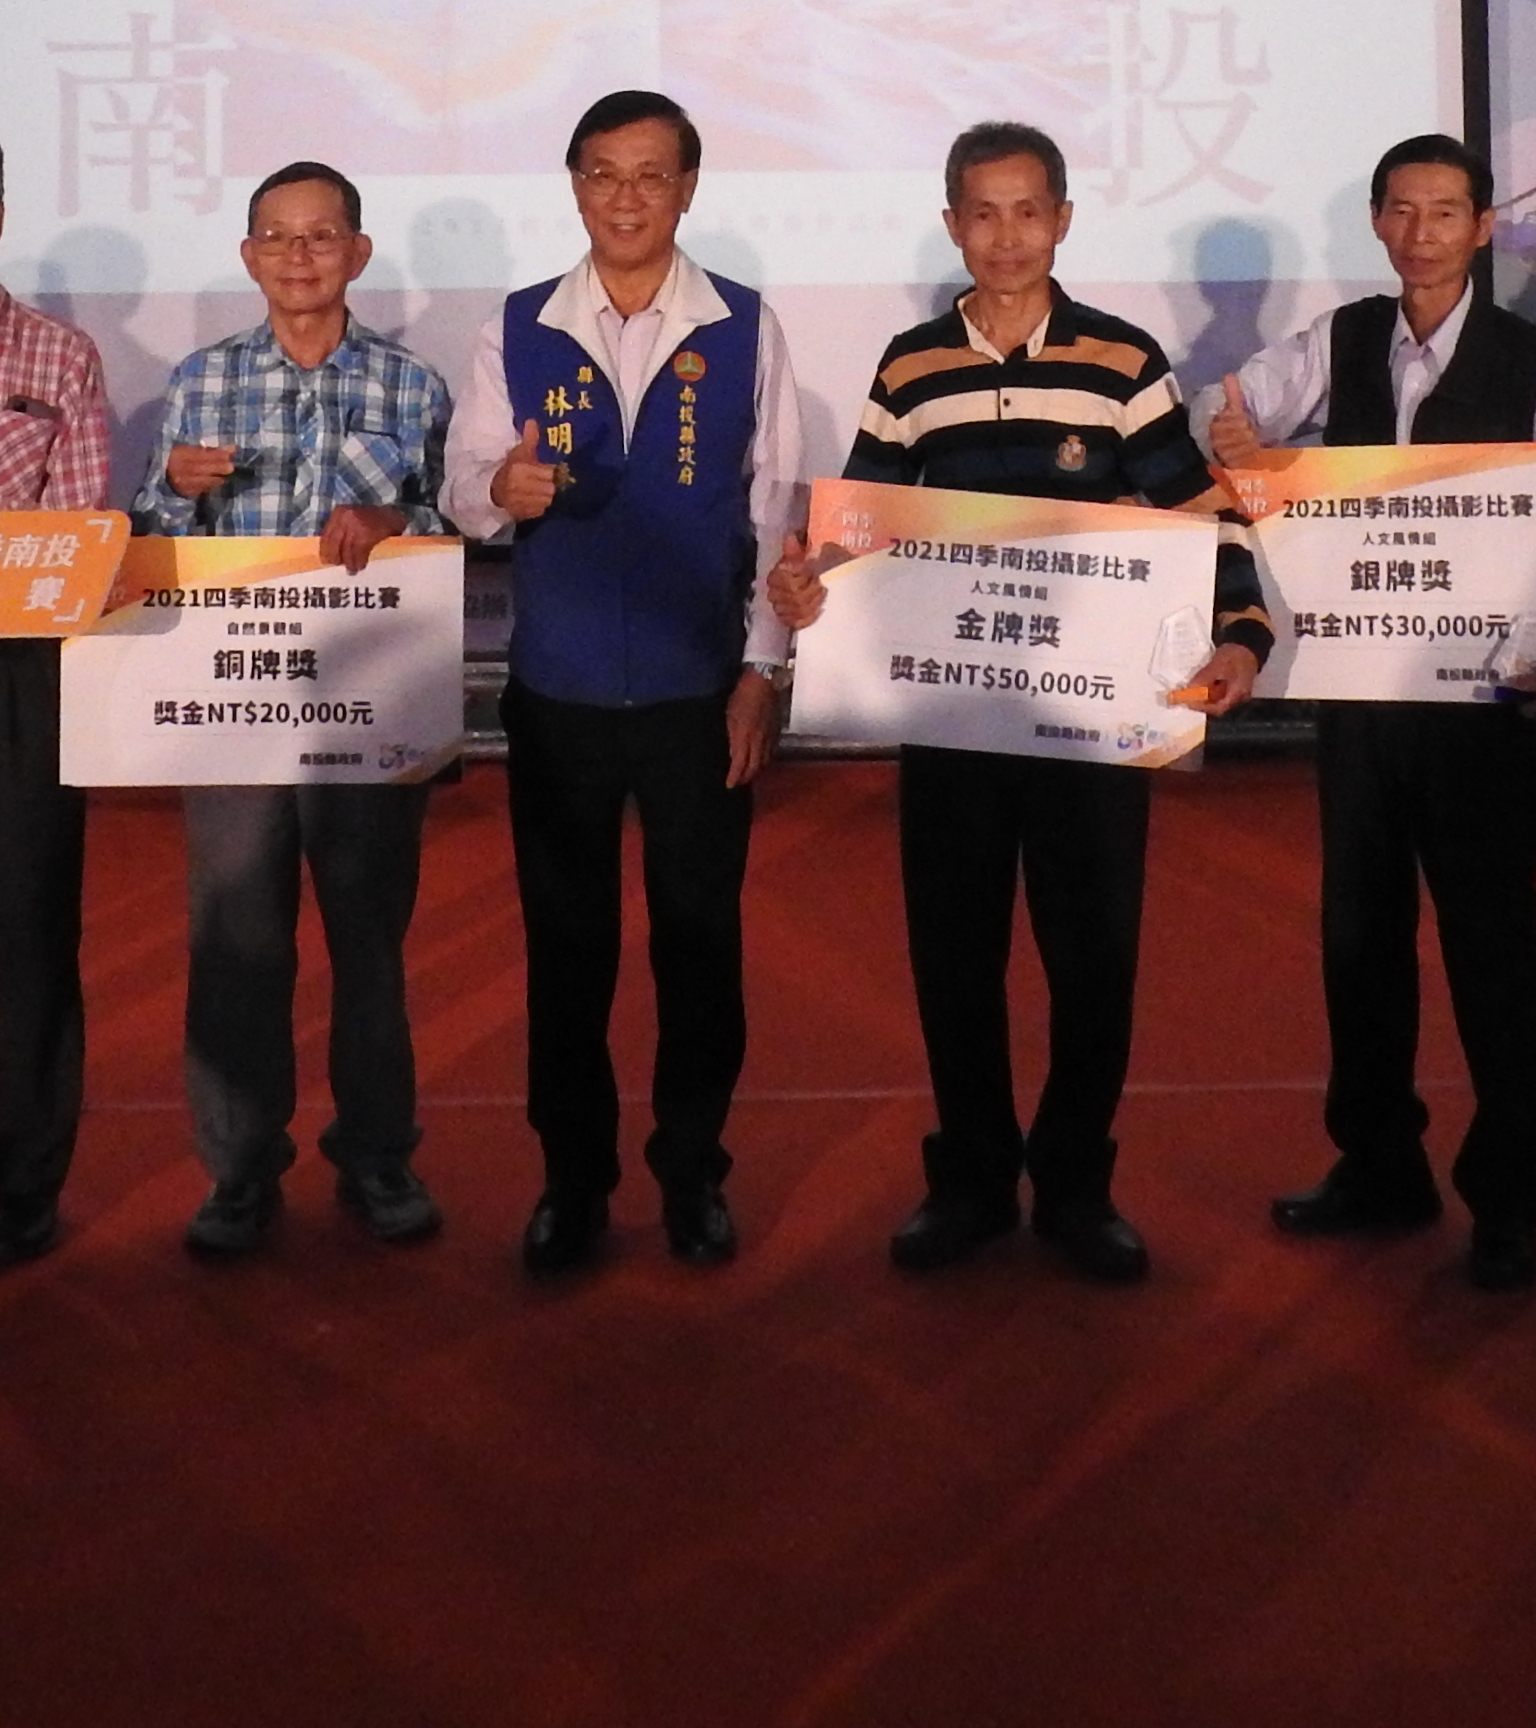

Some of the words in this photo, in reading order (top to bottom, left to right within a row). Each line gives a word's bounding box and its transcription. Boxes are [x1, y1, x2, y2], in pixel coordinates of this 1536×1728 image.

[45, 12, 230, 217] 南
[1073, 3, 1275, 210] 投
[1283, 494, 1533, 520] 2021四季南投攝影比賽
[888, 538, 1151, 583] 2021四季南投攝影比賽
[1350, 559, 1452, 592] 銀牌獎
[143, 587, 401, 610] 2021四季南投攝影比賽
[954, 608, 1062, 649] 金牌獎
[1293, 612, 1510, 641] 獎金NT$30,000元
[213, 649, 319, 681] 銅牌獎
[889, 654, 1116, 701] 獎金NT$50,000元
[154, 701, 374, 728] 獎金NT$20,000元
